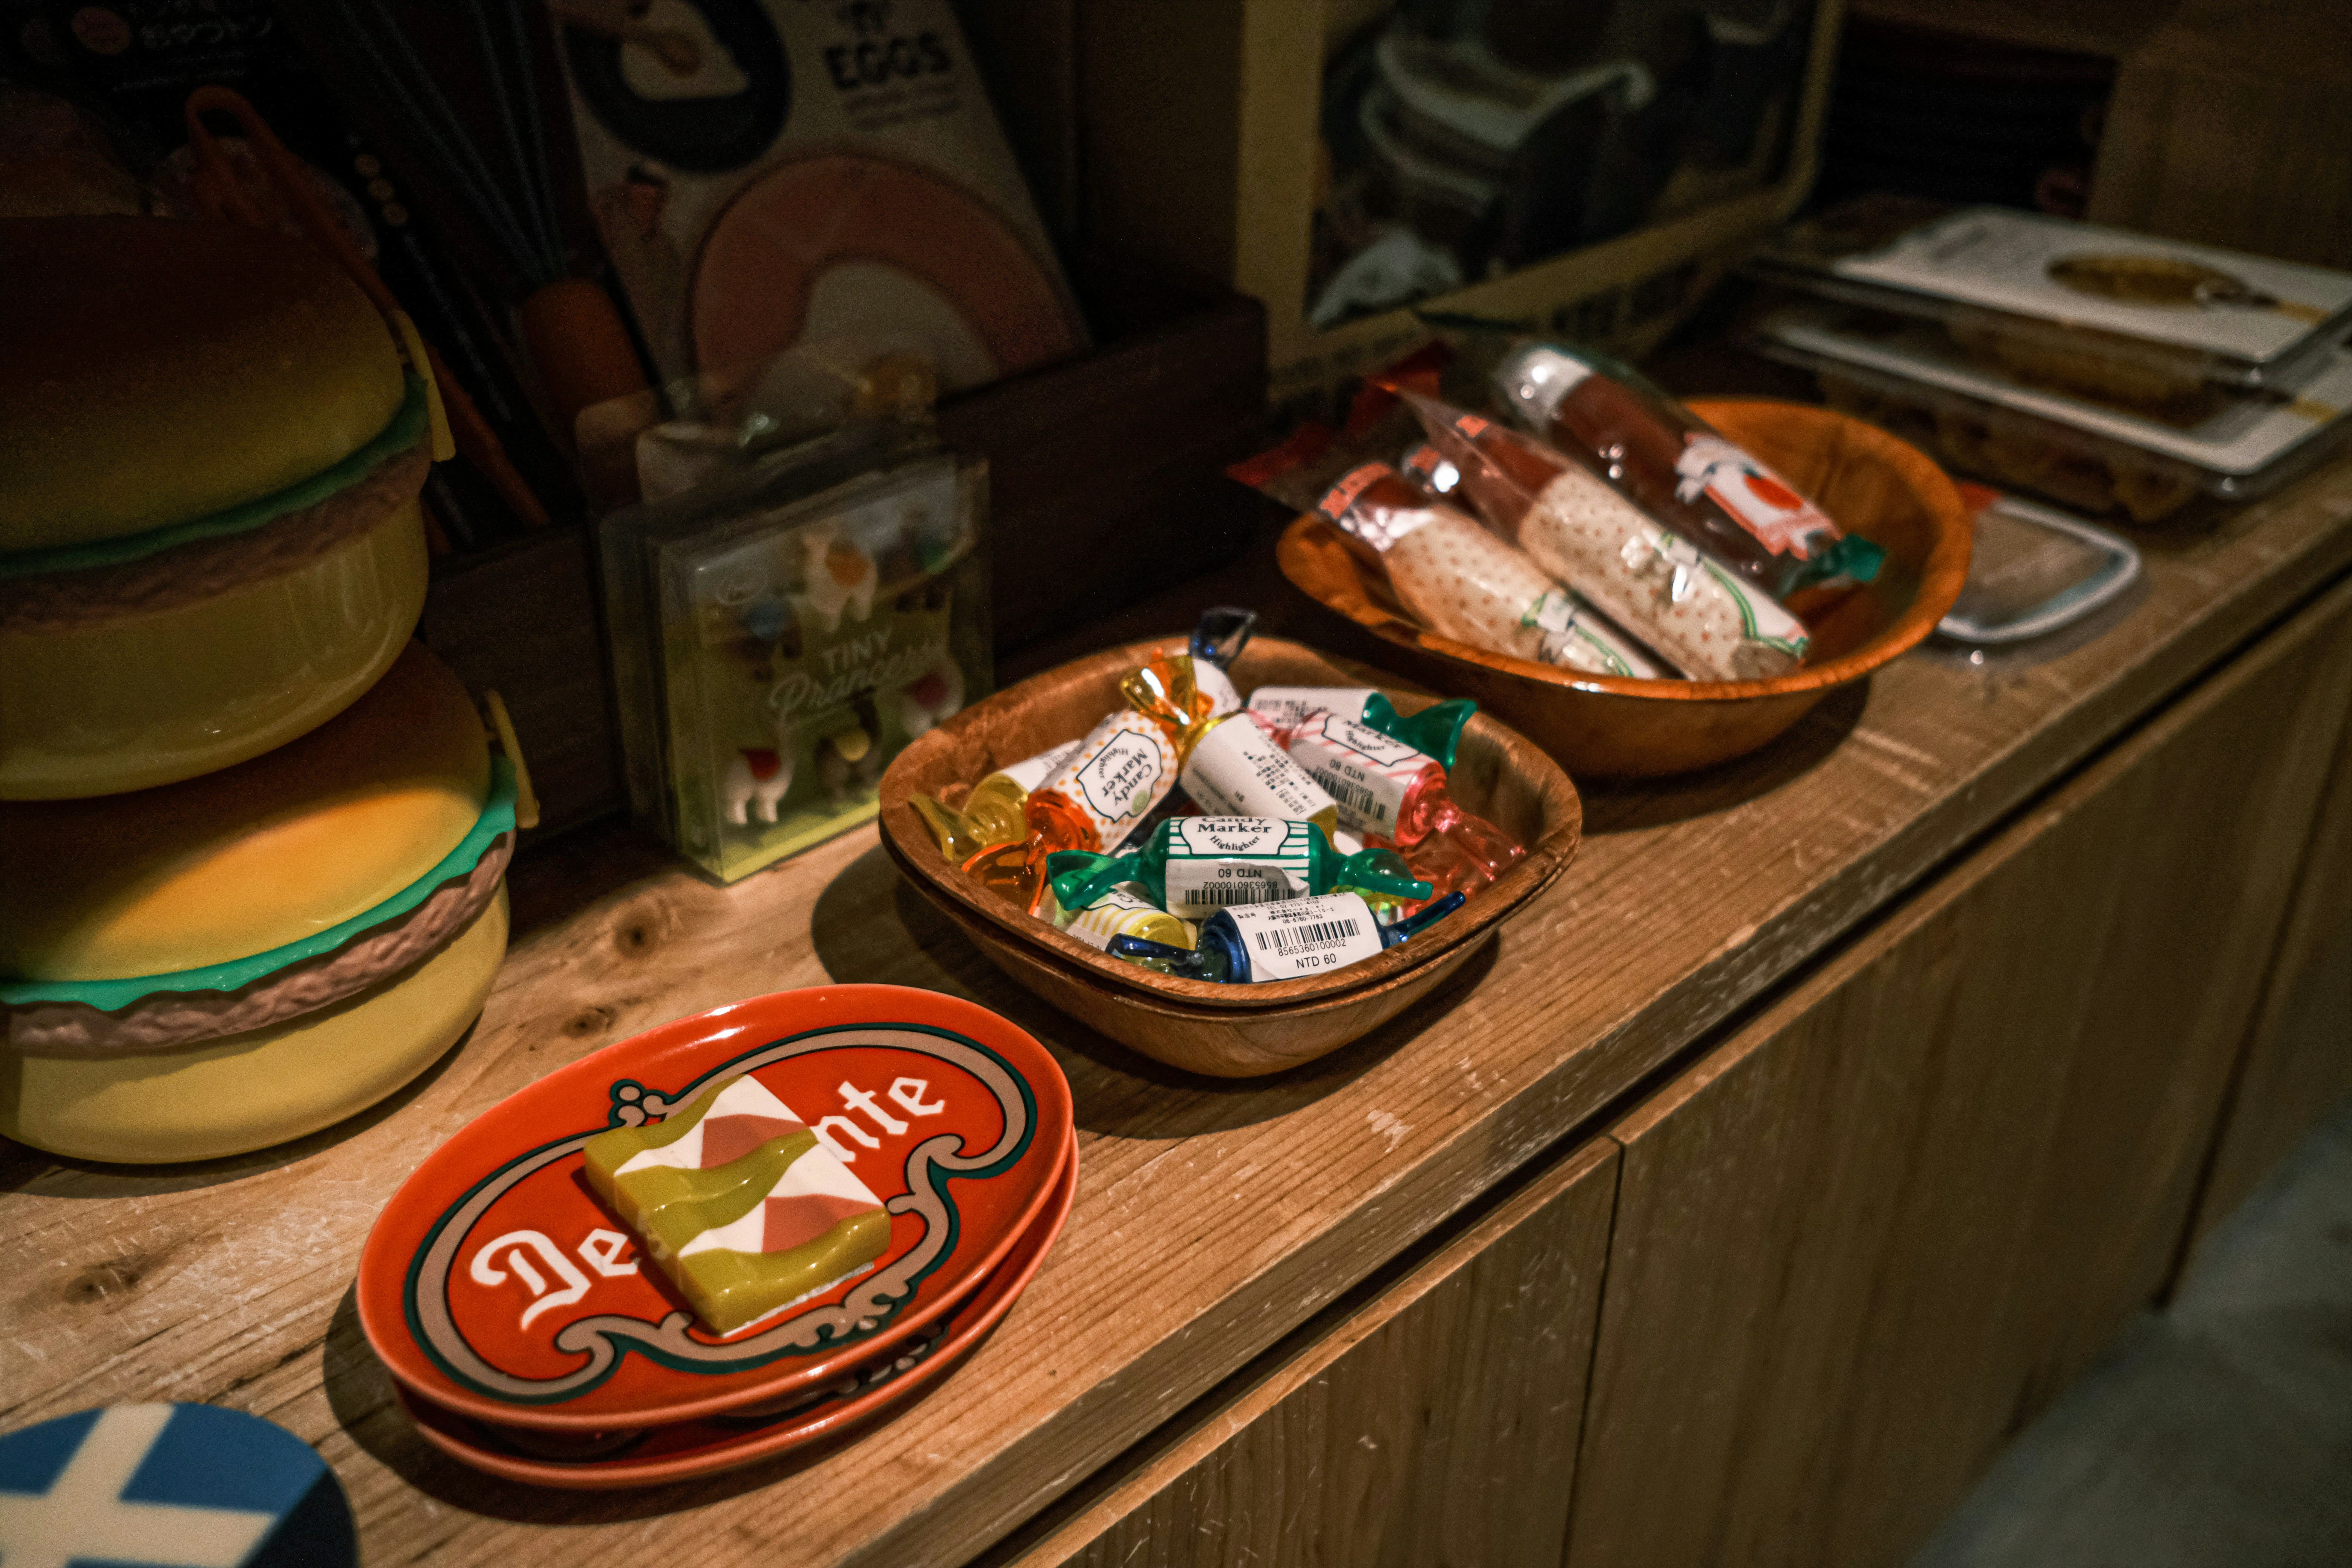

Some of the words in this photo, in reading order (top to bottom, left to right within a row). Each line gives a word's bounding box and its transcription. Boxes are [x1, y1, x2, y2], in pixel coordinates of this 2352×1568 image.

[822, 626, 893, 675] TINY
[1098, 748, 1129, 779] Highlighter
[1329, 759, 1341, 771] 60
[1102, 748, 1148, 797] Marker
[1344, 766, 1365, 782] NTD
[1113, 763, 1152, 806] Candy
[1197, 823, 1272, 833] Marker
[1209, 835, 1261, 852] Highlighter
[1218, 868, 1232, 878] 60
[1237, 869, 1262, 878] NTD
[1204, 881, 1277, 890] 8565360100002
[1277, 939, 1346, 957] 8565360100002
[1295, 956, 1320, 969] NTD
[1323, 953, 1337, 965] 60
[470, 1228, 640, 1333] De
[809, 1076, 945, 1163] nte
